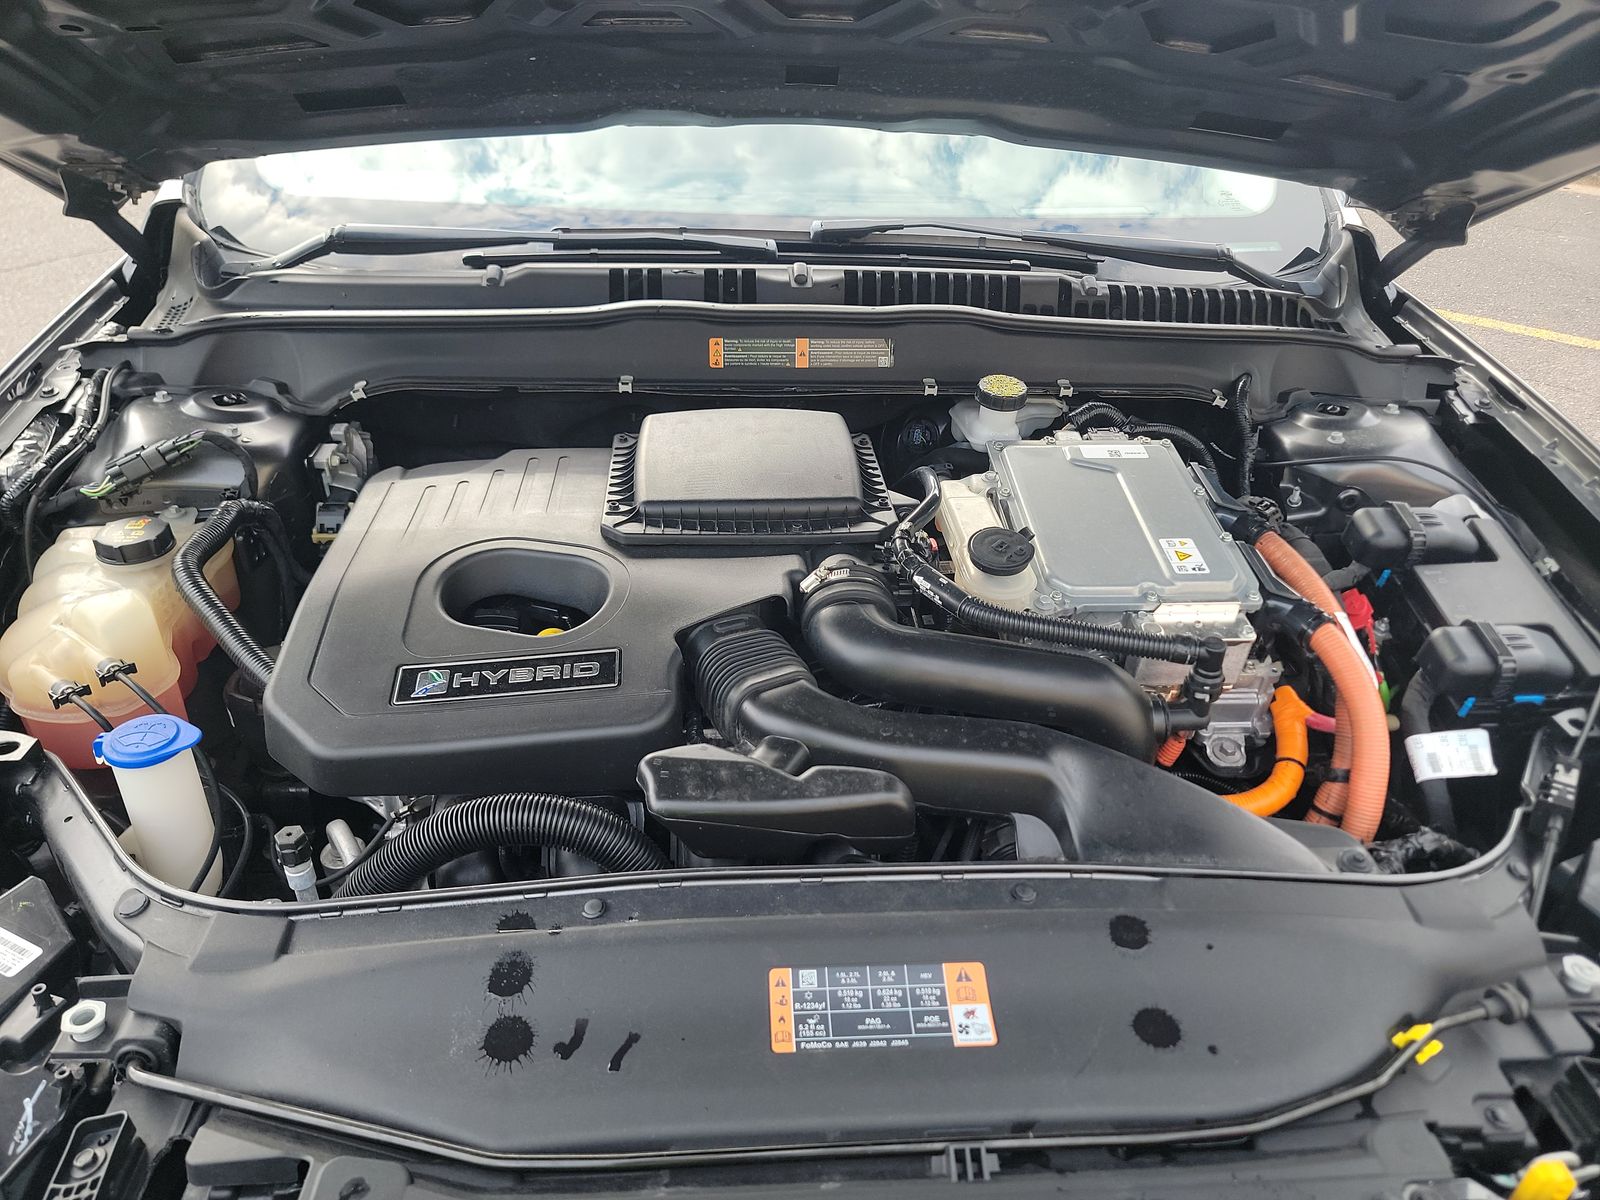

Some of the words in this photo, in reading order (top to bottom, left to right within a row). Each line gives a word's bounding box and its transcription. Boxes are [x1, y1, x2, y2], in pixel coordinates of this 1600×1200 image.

[452, 661, 600, 688] HYBRID
[854, 989, 863, 998] kg
[893, 988, 902, 997] kg
[794, 1001, 825, 1010] R-1234yf
[800, 1040, 833, 1049] FoMoCo
